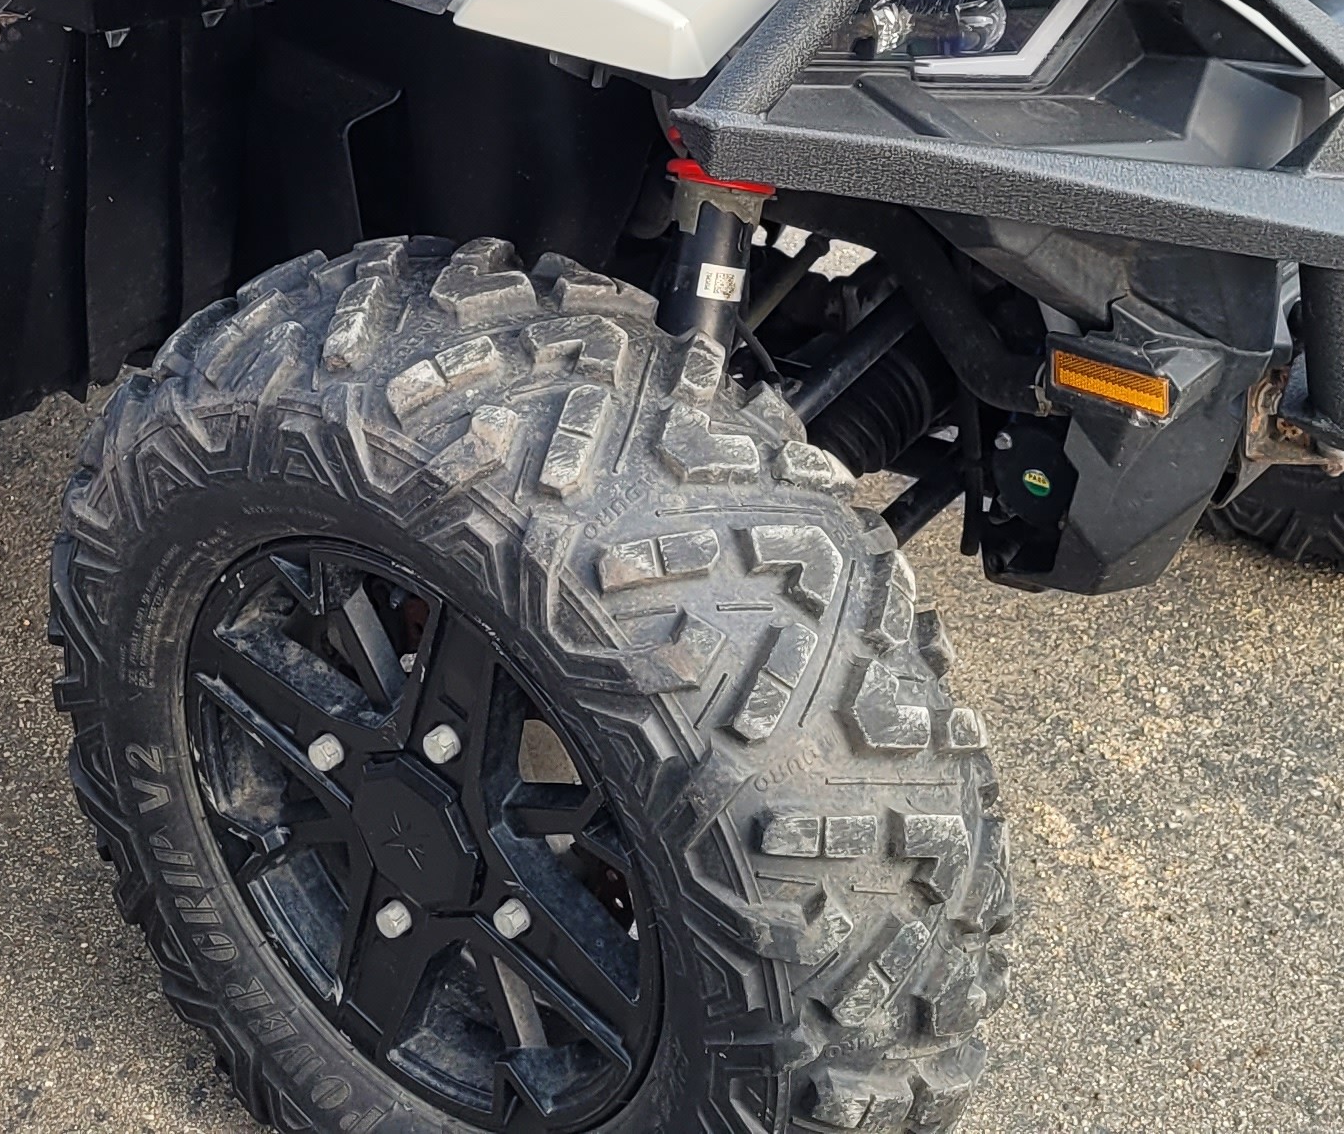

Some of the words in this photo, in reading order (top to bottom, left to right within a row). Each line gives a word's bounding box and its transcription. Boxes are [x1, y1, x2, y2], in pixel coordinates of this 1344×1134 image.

[124, 743, 171, 815] V2
[148, 825, 236, 963] GRIP
[225, 976, 385, 1134] POWER
